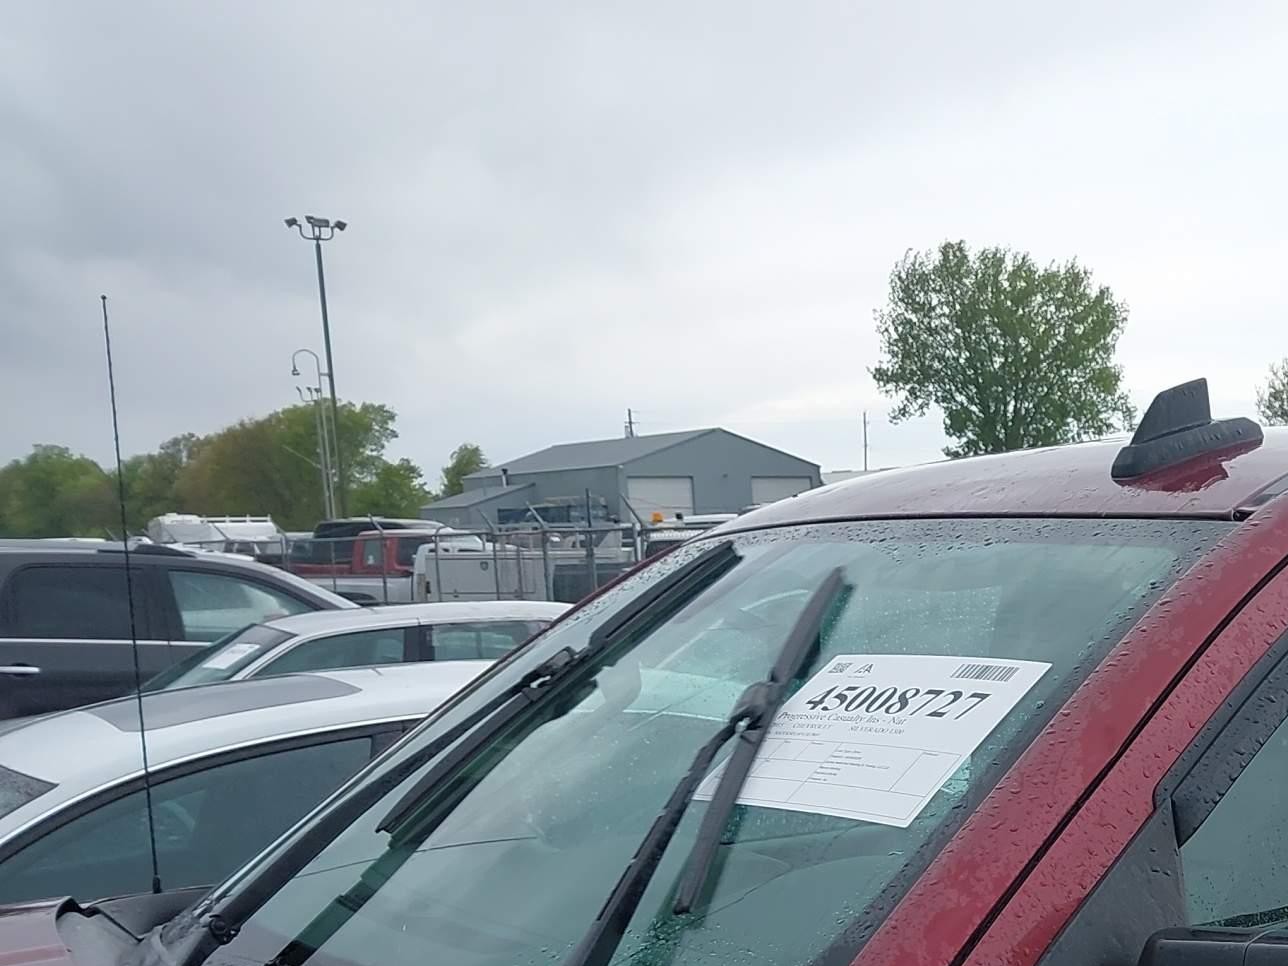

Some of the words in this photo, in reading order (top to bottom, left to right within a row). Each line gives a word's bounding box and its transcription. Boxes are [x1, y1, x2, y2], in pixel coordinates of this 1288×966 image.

[806, 685, 992, 720] 45008727
[777, 711, 827, 722] Progressive
[828, 712, 865, 725] Casualty
